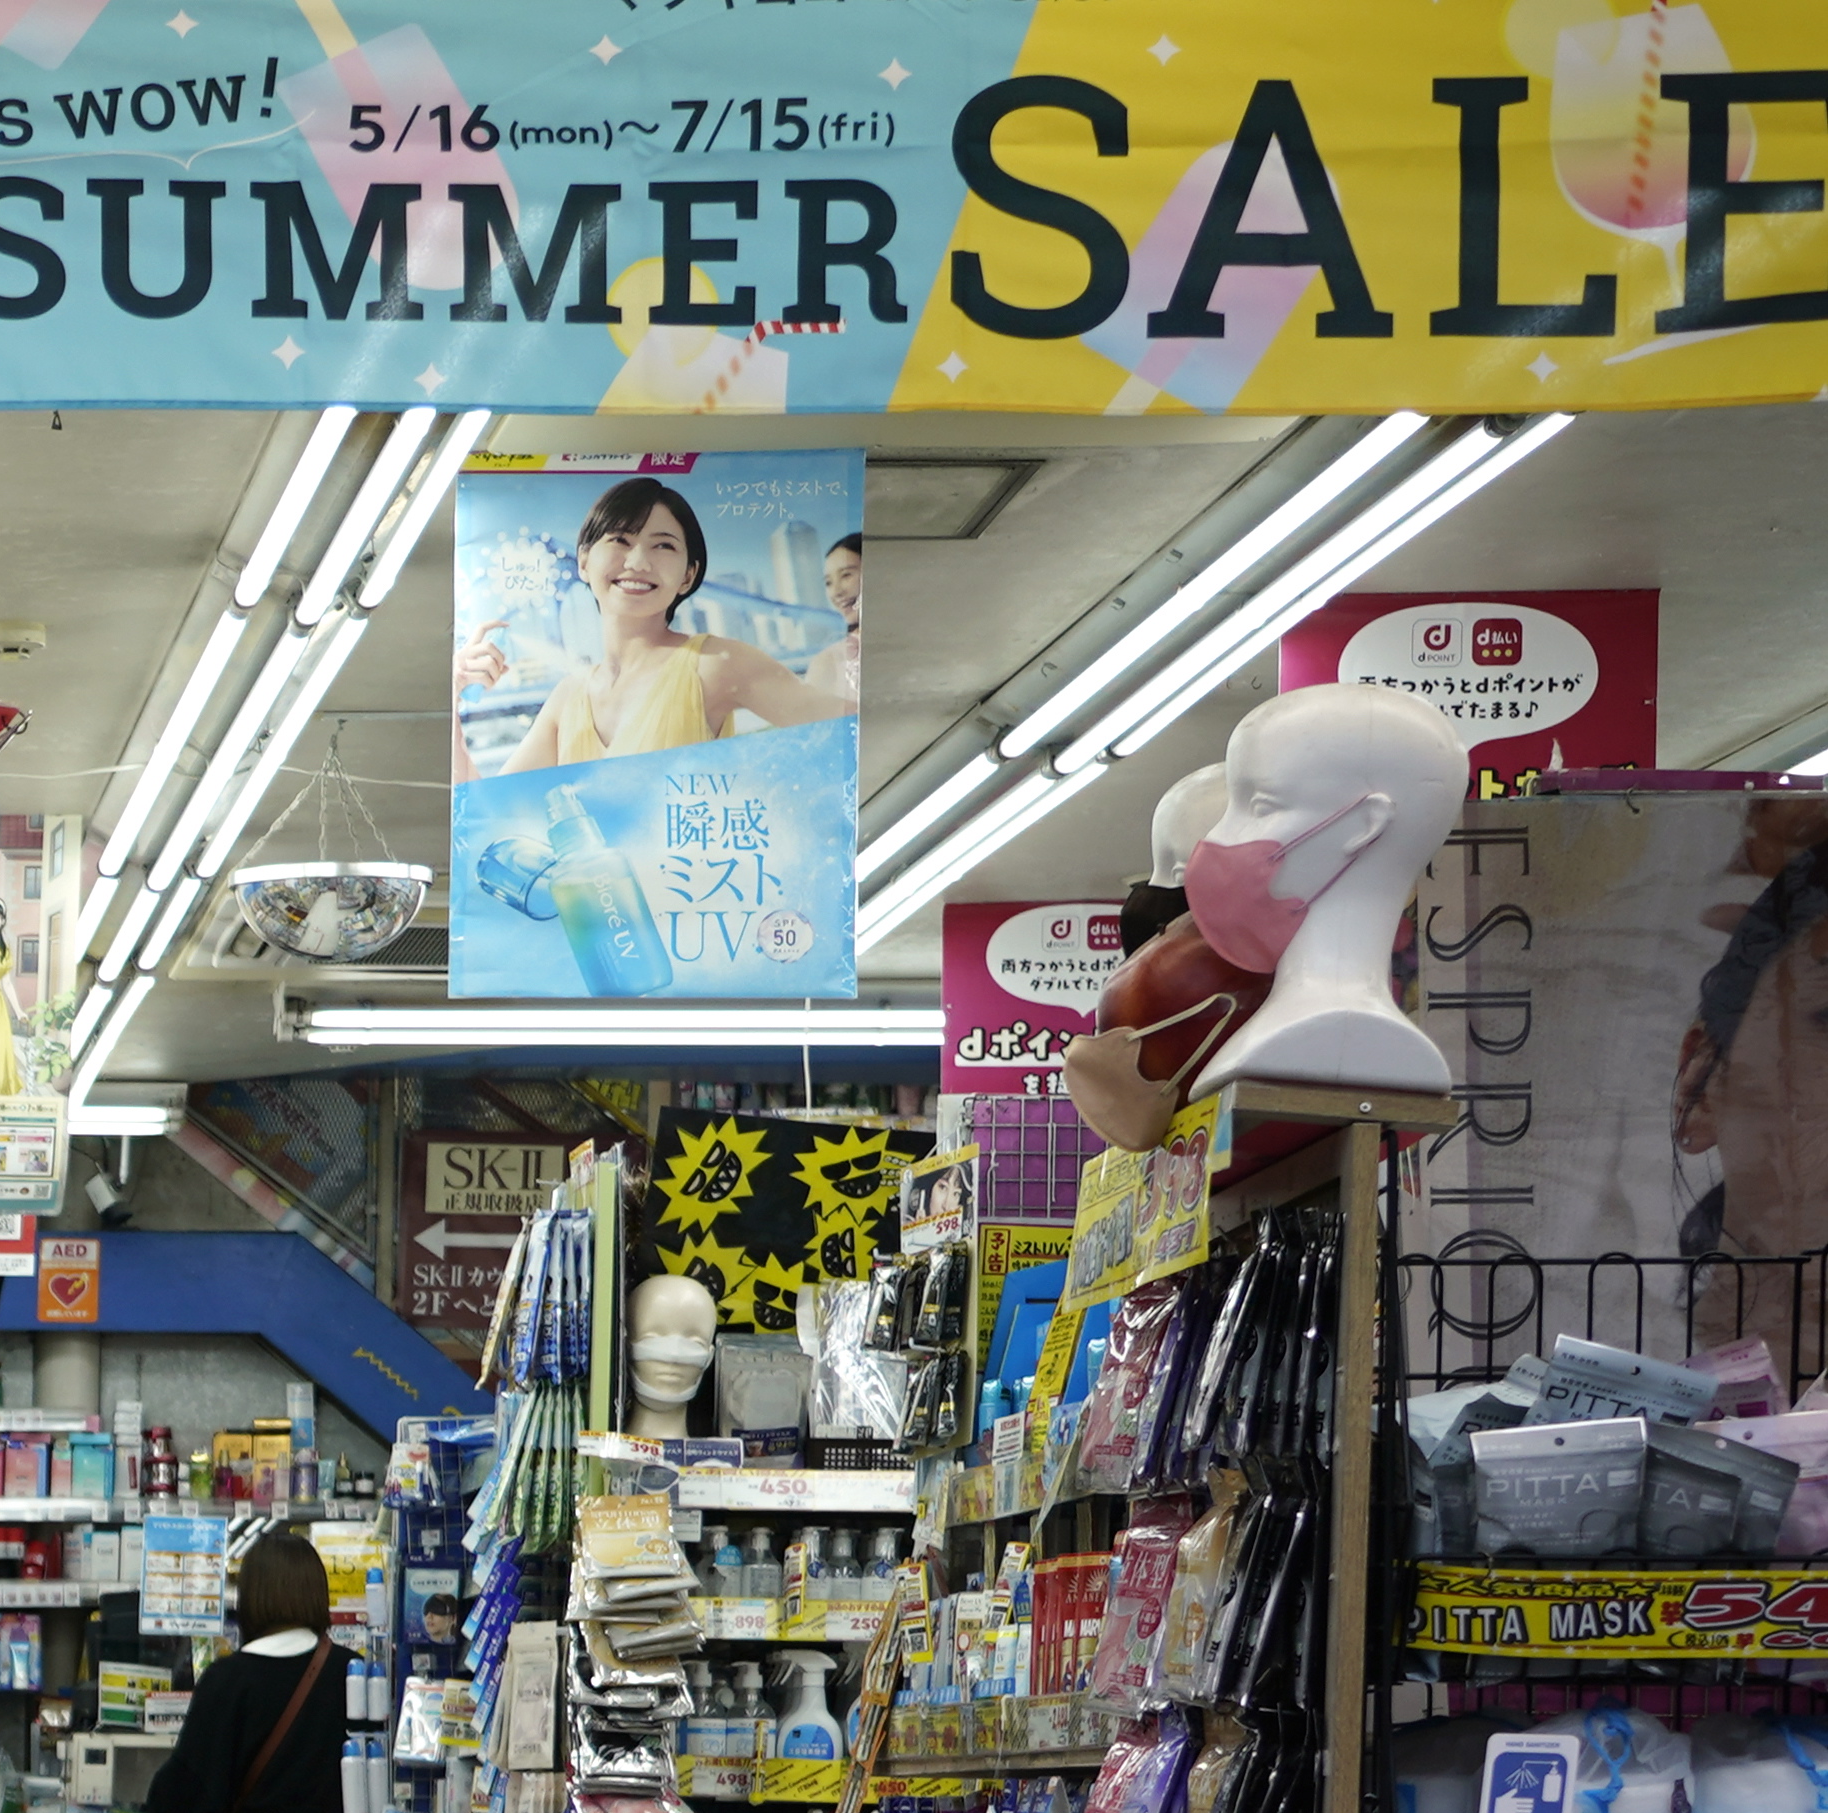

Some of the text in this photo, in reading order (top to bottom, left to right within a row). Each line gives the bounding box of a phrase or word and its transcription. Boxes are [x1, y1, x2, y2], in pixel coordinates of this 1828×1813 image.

[54, 56, 282, 140] wow!
[950, 74, 1828, 342] SALE
[664, 773, 738, 796] NEW
[666, 799, 771, 851] 瞬感
[660, 853, 784, 905] ミスト
[665, 910, 755, 963] UV
[773, 928, 797, 948] 50
[52, 1244, 88, 1258] AED
[1486, 1472, 1601, 1498] PITTA
[1550, 1600, 1652, 1639] MASK
